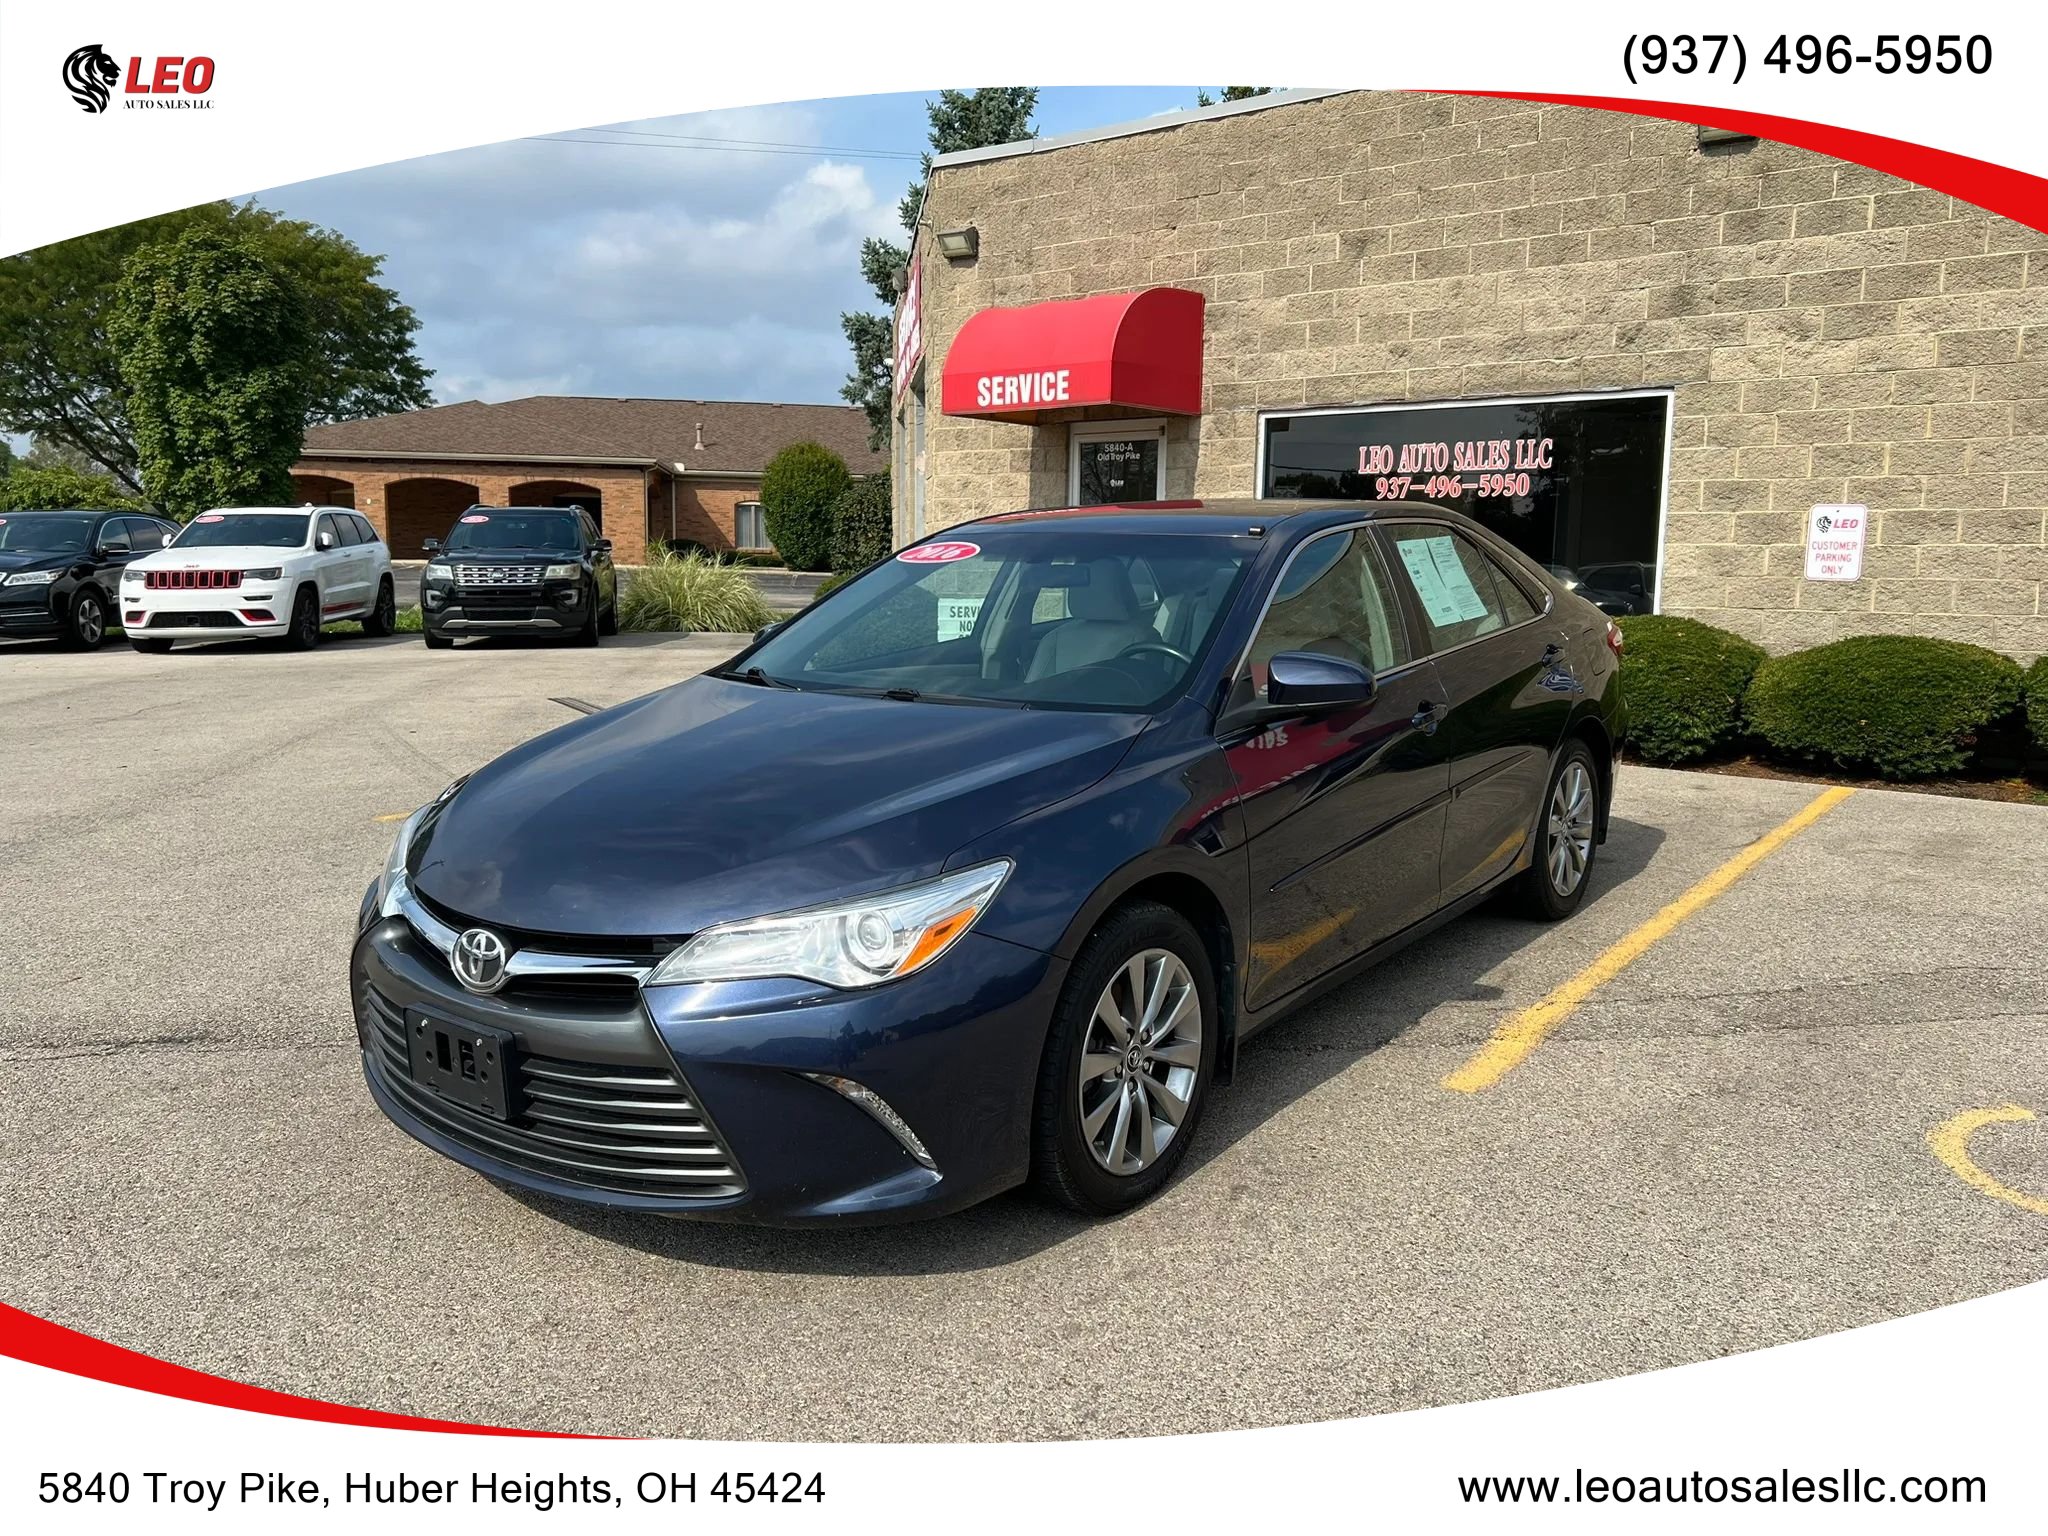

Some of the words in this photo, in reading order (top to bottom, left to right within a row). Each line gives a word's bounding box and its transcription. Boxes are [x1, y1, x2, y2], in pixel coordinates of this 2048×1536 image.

[977, 369, 1070, 407] SERVICE
[1104, 442, 1133, 452] 5840-A
[1097, 453, 1109, 461] Old
[1125, 452, 1140, 460] Pike
[1358, 444, 1394, 474] LEO
[1397, 442, 1449, 473] AUTO
[1453, 440, 1510, 472] SALES
[1514, 438, 1553, 469] LLC
[1375, 472, 1530, 500] 937-496-5950
[1833, 519, 1859, 529] LEO
[1811, 541, 1858, 551] CUSTOMER
[1815, 553, 1852, 563] PARKING
[1821, 565, 1843, 575] ONLY
